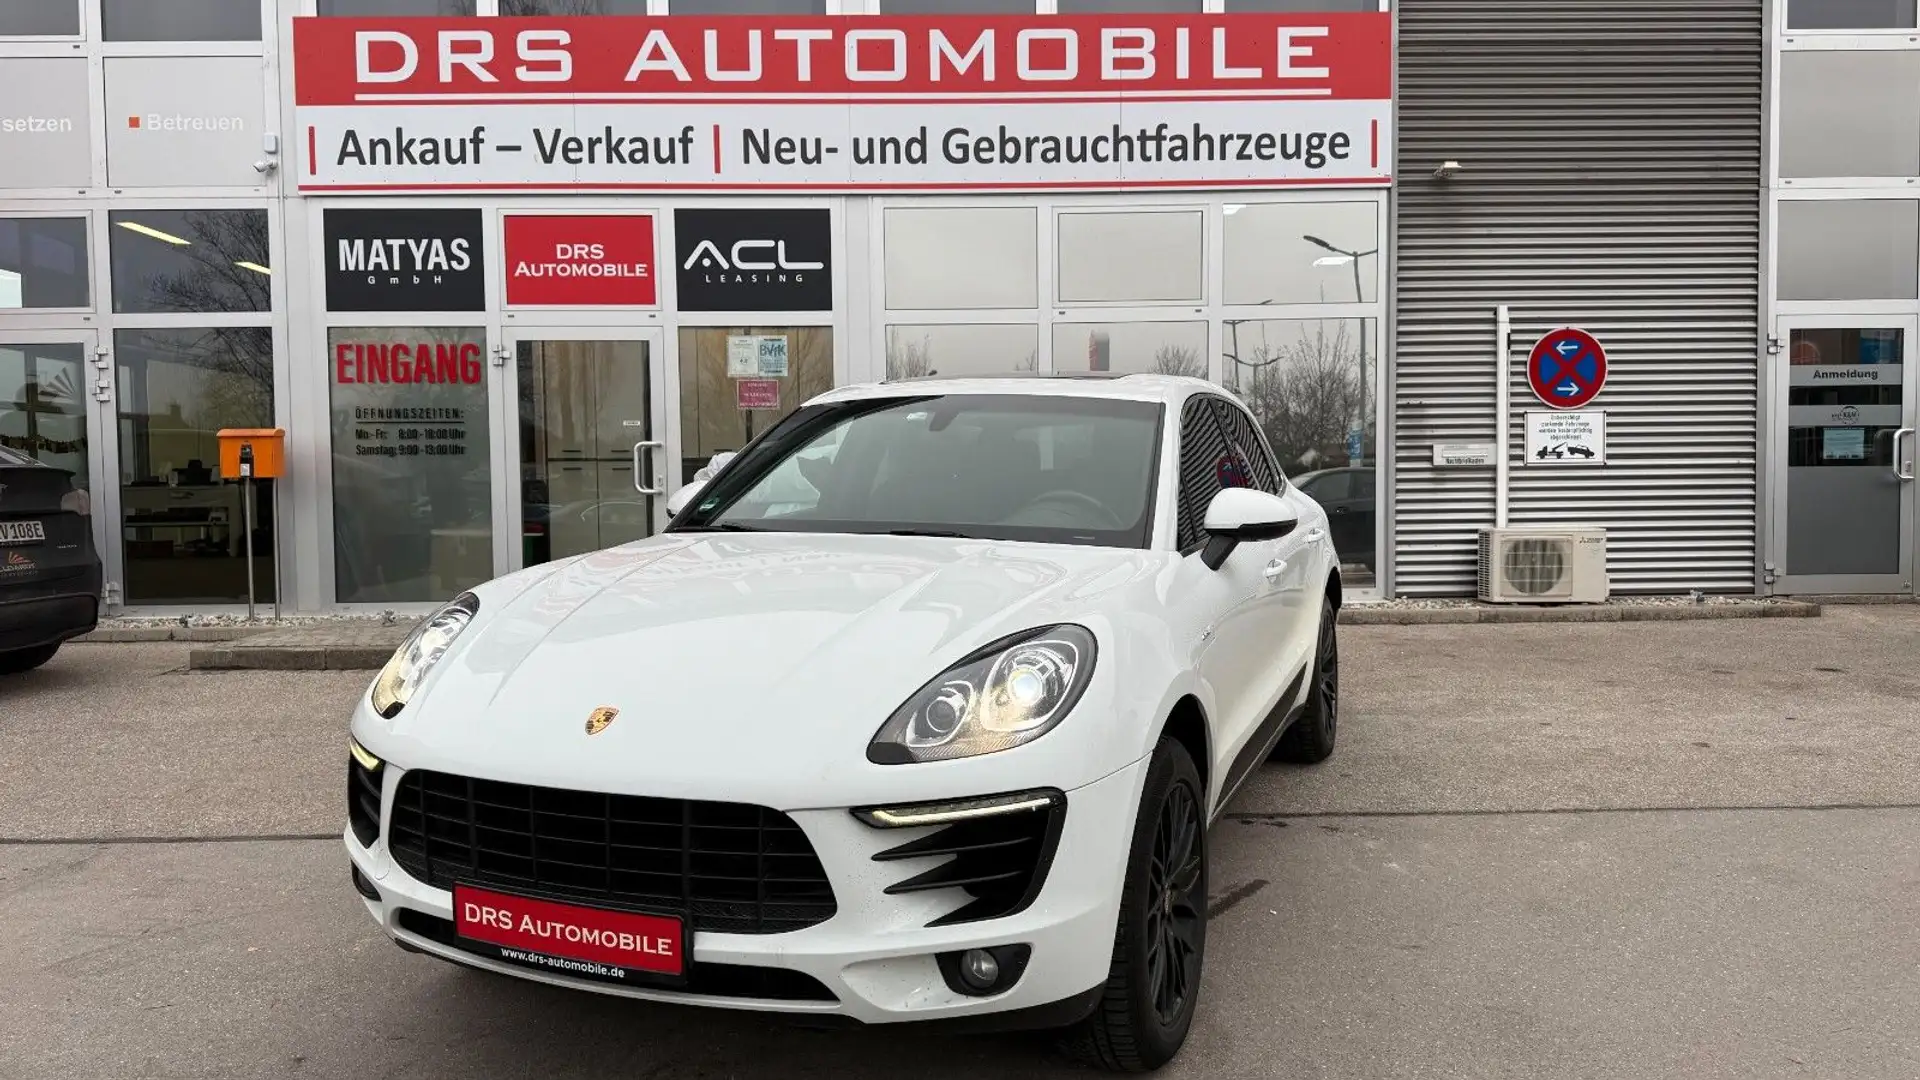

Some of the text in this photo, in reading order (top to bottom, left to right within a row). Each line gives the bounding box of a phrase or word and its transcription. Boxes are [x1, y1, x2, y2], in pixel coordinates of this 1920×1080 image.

[354, 26, 1330, 83] DRS AUTOMOBILE
[0, 115, 72, 132] setzen
[147, 113, 245, 132] Betreuen
[337, 127, 485, 166] Ankauf
[533, 125, 694, 166] Verkauf
[742, 123, 1351, 169] Neu- und Gebrauchtfahrzeuge
[338, 238, 471, 272] MATYAS
[556, 243, 605, 261] DRS
[683, 240, 825, 270] ACL
[513, 260, 648, 278] AUTOMOBILE
[704, 274, 804, 283] LEASING
[336, 343, 482, 385] EINGANG
[1812, 369, 1880, 380] Anmeldung
[355, 406, 465, 419] ÖFFNUNGSZEITEN:
[448, 428, 466, 440] Uhr
[448, 443, 466, 456] Uhr
[464, 902, 674, 957] DRS AUTOMOBILE
[500, 947, 626, 978] www.drs-automobile.de
